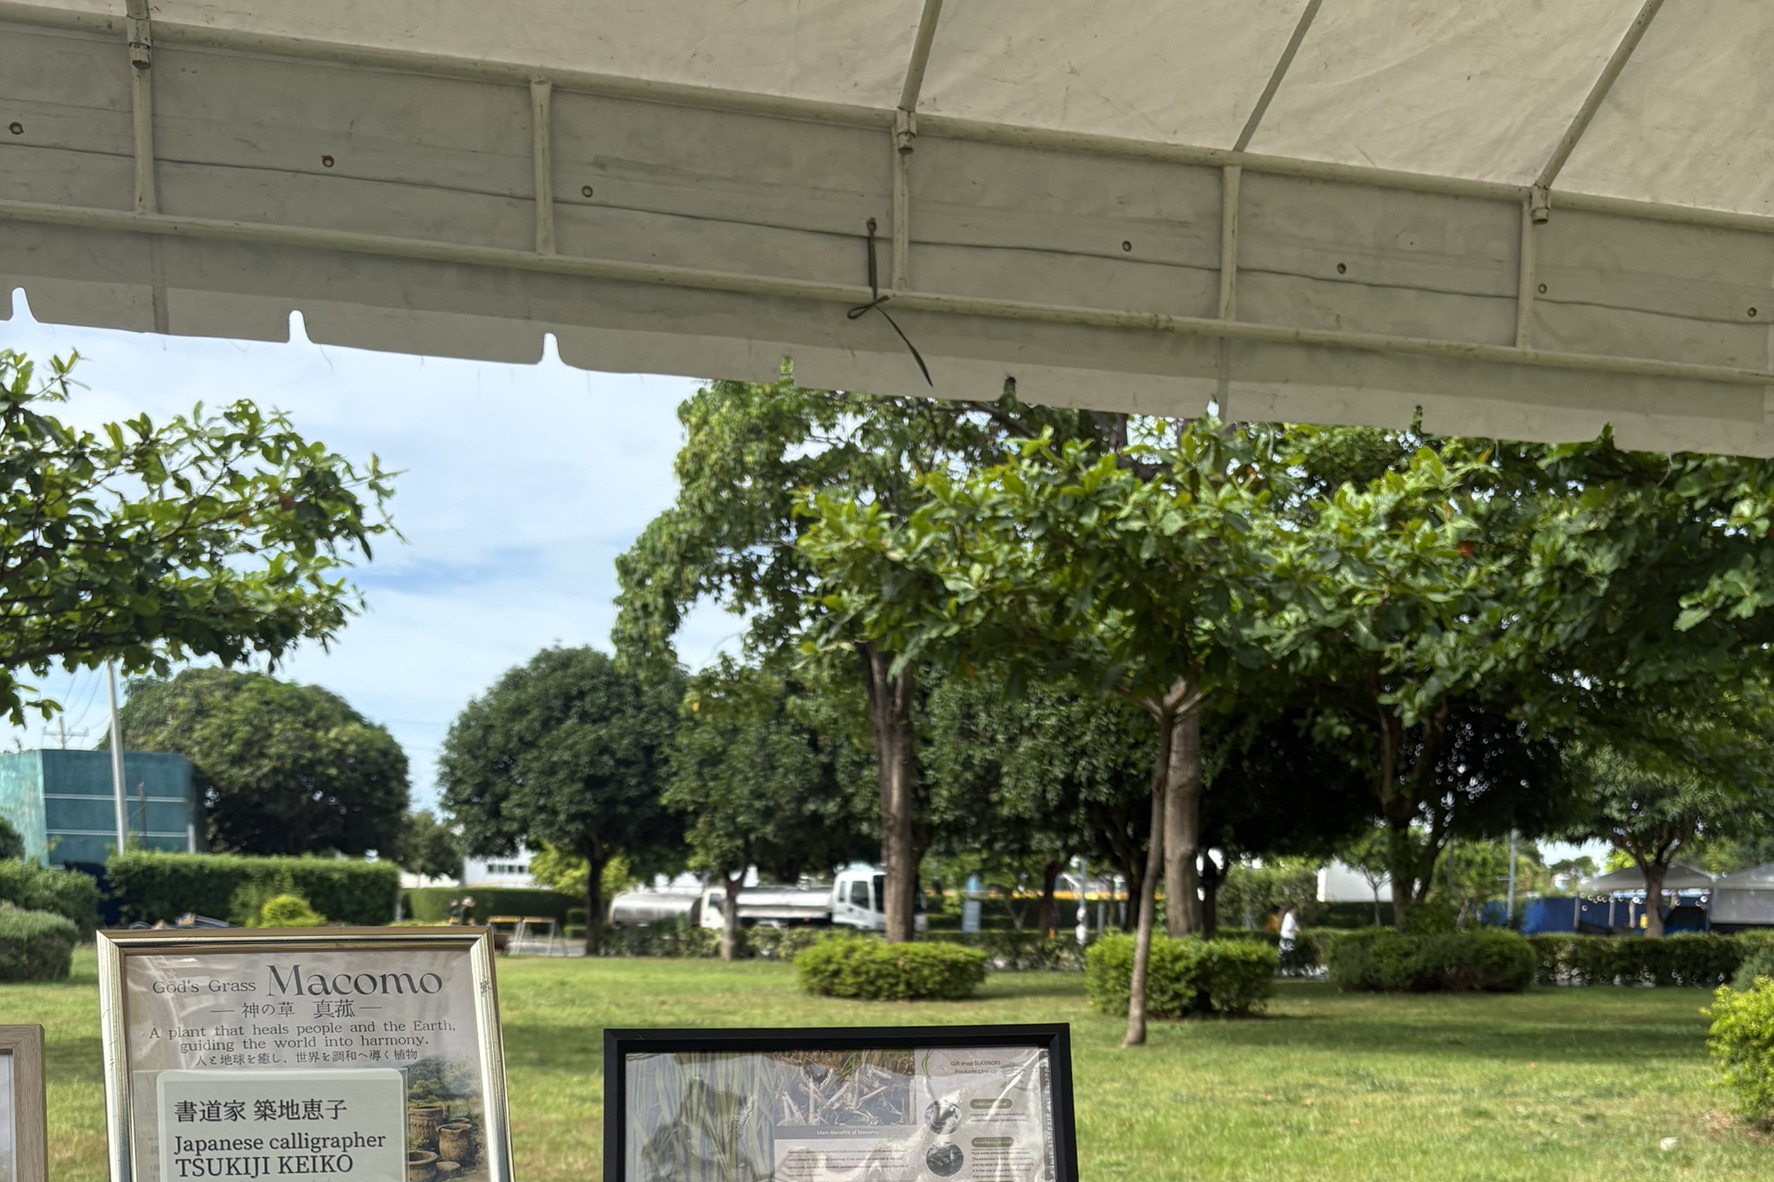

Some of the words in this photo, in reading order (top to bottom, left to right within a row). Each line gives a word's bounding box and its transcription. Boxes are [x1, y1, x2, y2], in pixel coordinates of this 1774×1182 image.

[152, 980, 199, 994] God's
[208, 979, 256, 993] Grass
[266, 964, 443, 997] Macomo
[241, 1002, 295, 1019] 神の草
[313, 999, 355, 1019] 真菰
[149, 1028, 160, 1039] A
[169, 1026, 207, 1040] plant
[215, 1025, 244, 1036] that
[253, 1023, 289, 1035] heals
[297, 1021, 343, 1036] people
[350, 1020, 376, 1032] and
[384, 1020, 406, 1032] the
[413, 1019, 456, 1032] Earth,
[180, 1039, 235, 1053] guiding
[243, 1038, 266, 1050] the
[274, 1036, 317, 1049] world
[325, 1036, 353, 1047] into
[361, 1034, 429, 1047] harmony.
[174, 1100, 247, 1123] 書道家
[253, 1098, 348, 1122] 築地恵子
[174, 1135, 264, 1156] Japanese
[269, 1131, 386, 1154] calligrapher
[175, 1157, 271, 1178] TSUKIJI
[277, 1154, 354, 1175] KEIKO
